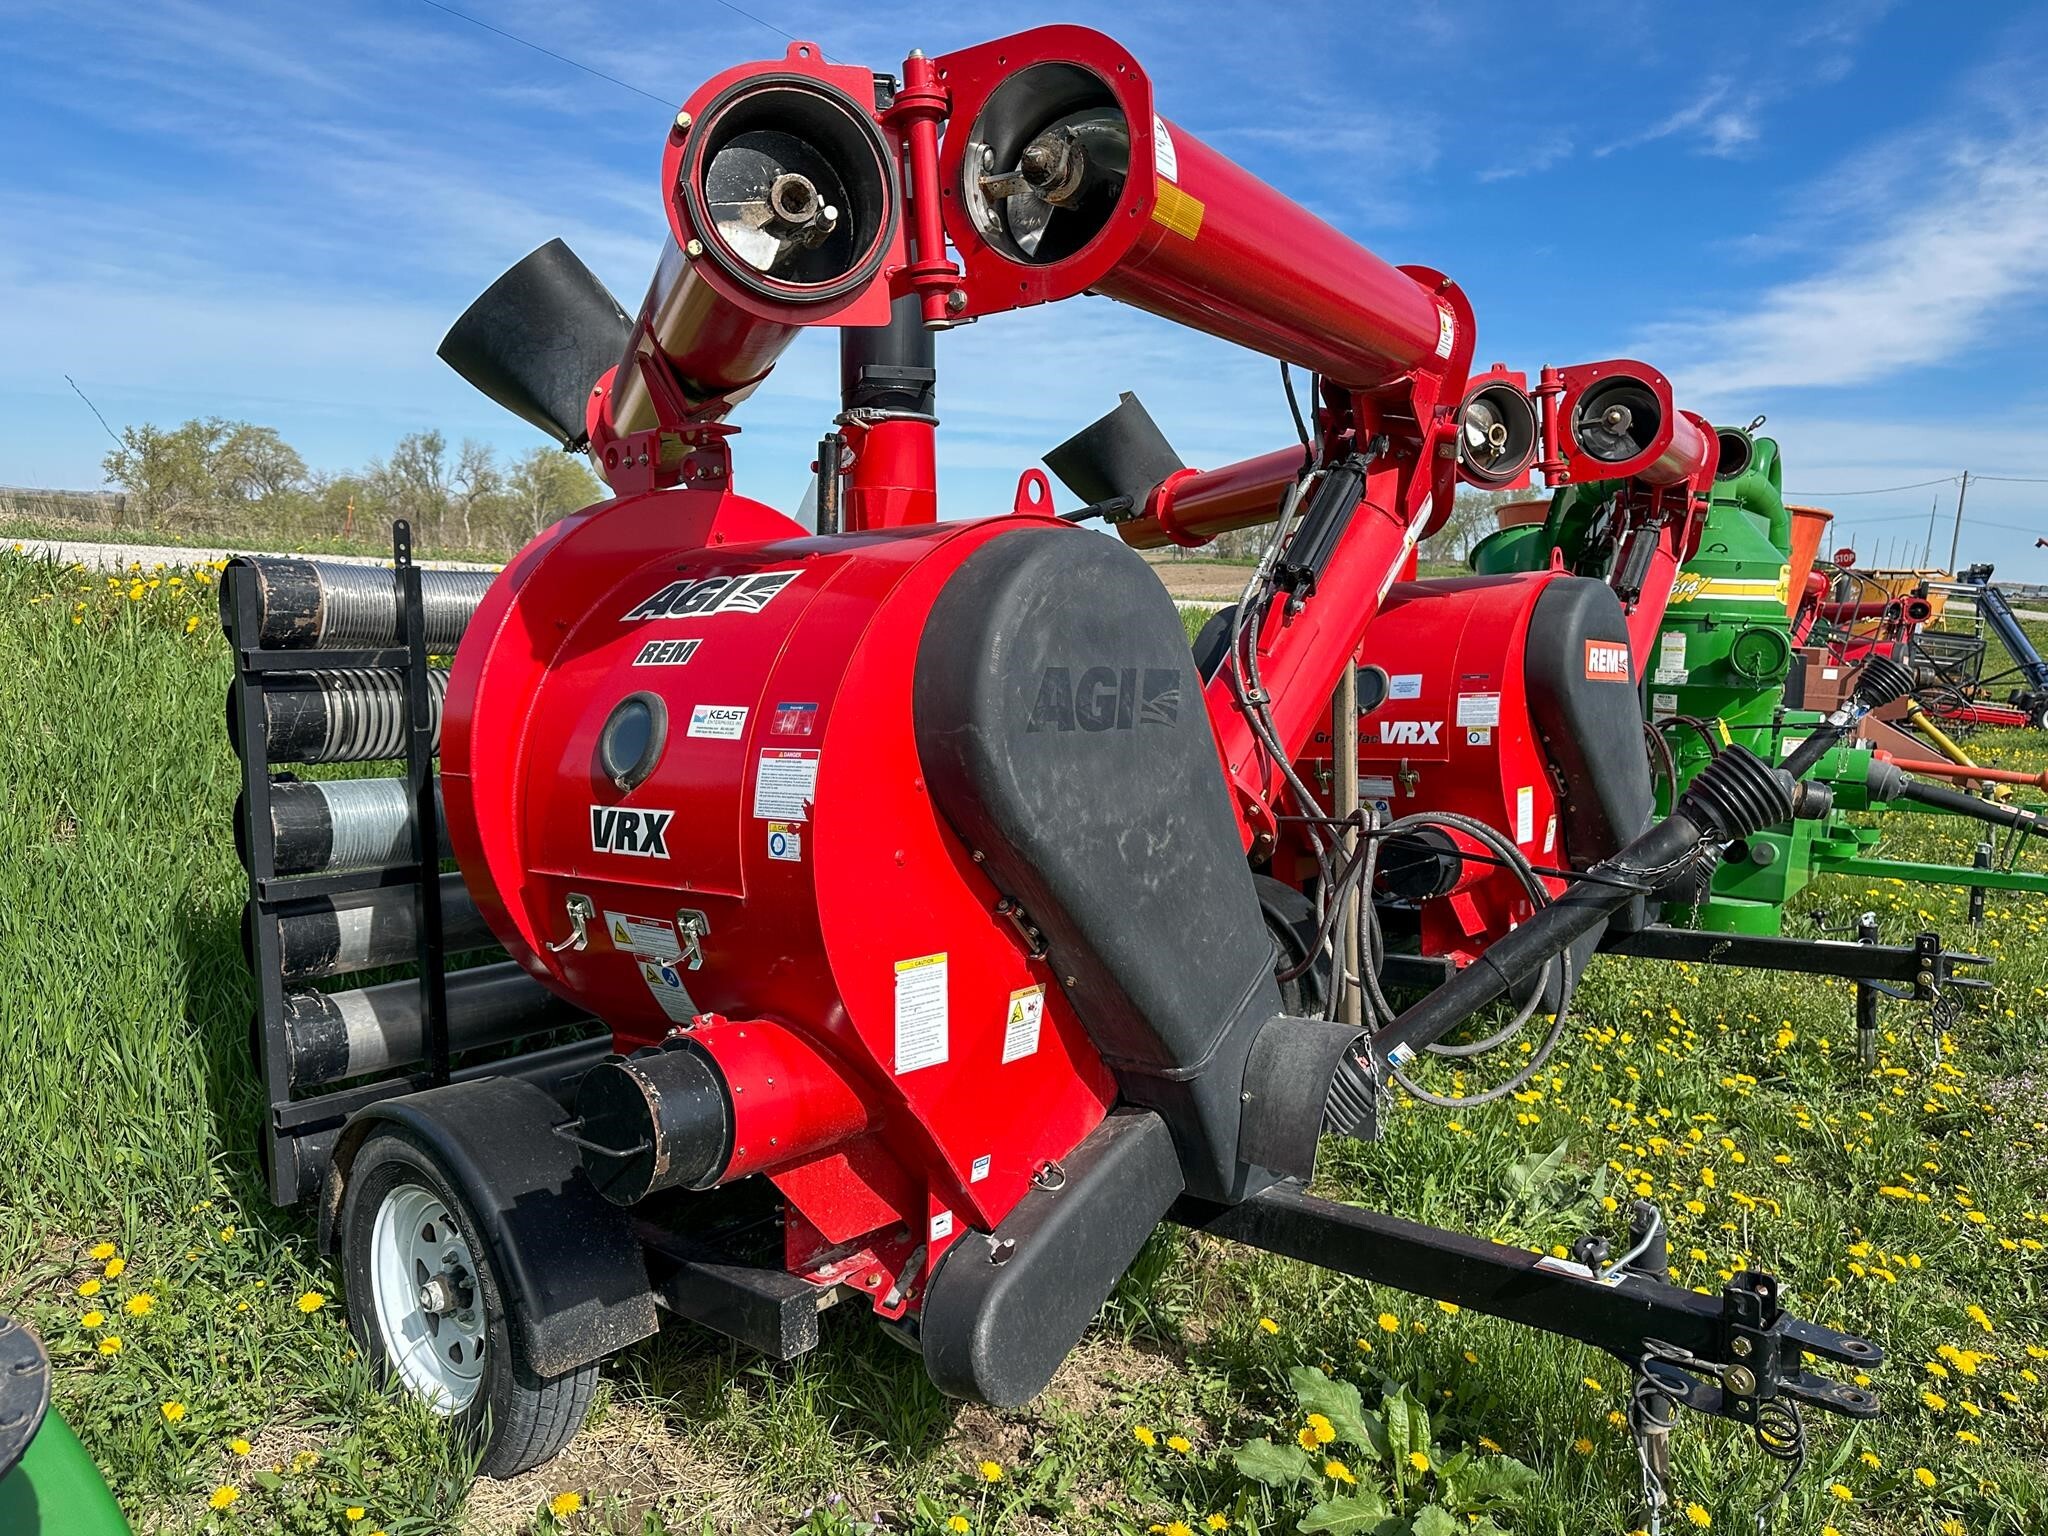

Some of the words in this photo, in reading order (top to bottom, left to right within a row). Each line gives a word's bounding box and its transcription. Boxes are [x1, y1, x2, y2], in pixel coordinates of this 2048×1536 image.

[1835, 553, 1855, 563] STOP
[630, 576, 743, 619] AGI
[636, 641, 698, 664] REM
[1588, 647, 1619, 673] REM
[1026, 666, 1137, 732] AGI
[709, 710, 746, 720] KEAST
[1380, 721, 1443, 745] VRX
[592, 809, 670, 856] VRX
